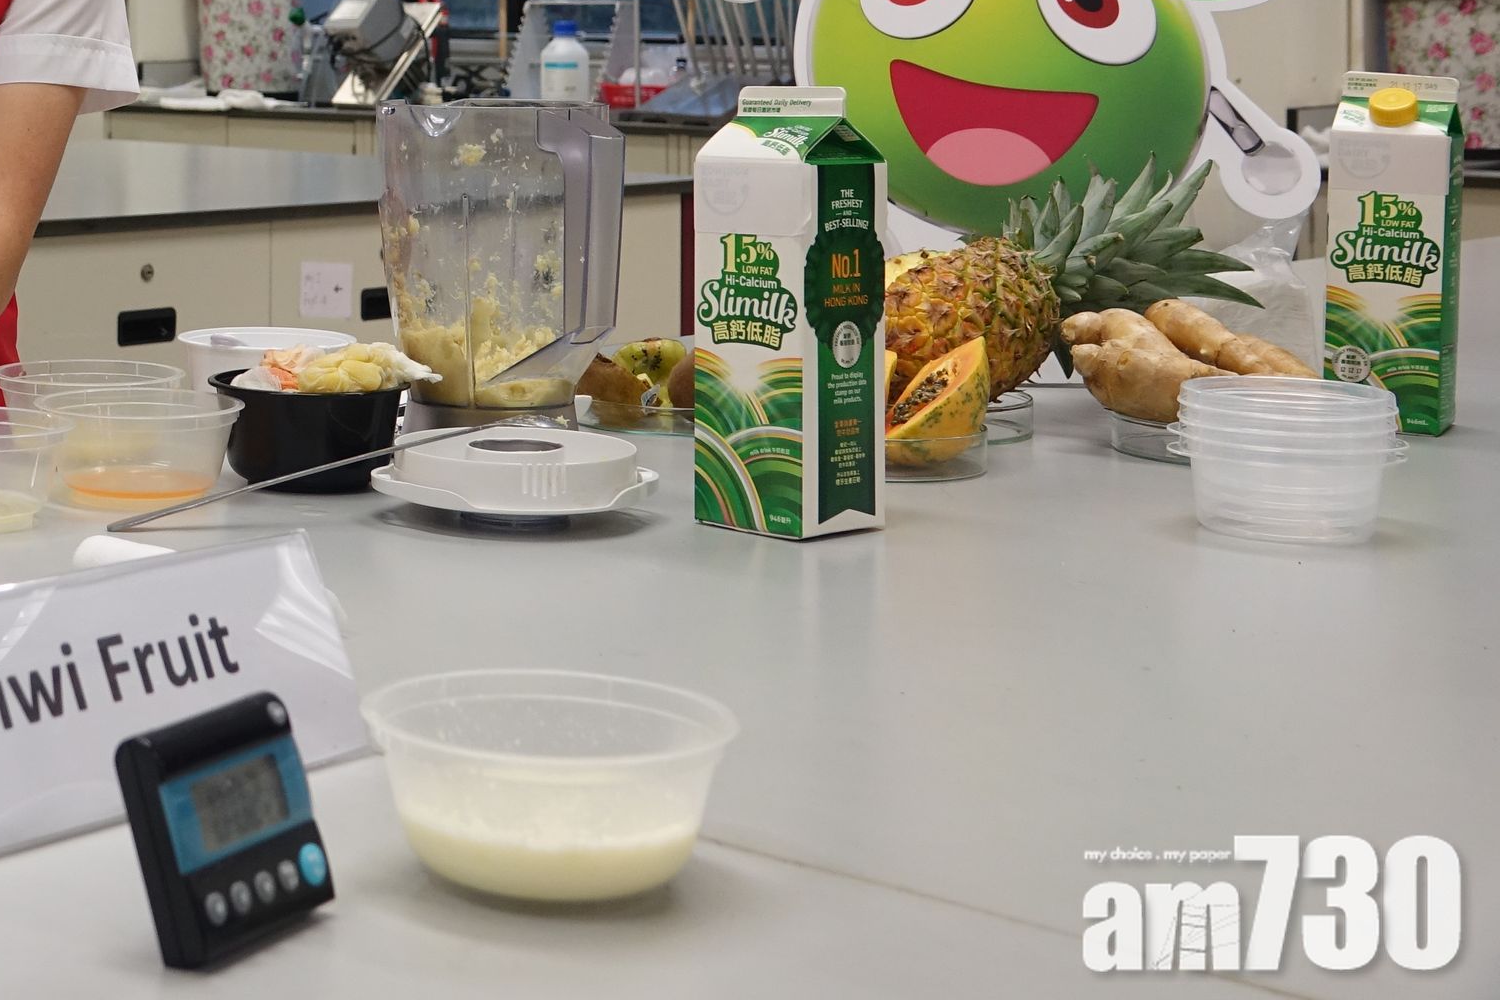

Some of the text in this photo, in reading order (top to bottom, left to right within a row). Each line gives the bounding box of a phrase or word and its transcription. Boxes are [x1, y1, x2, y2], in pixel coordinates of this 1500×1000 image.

[790, 99, 812, 107] Delivery
[840, 189, 854, 198] THE
[831, 199, 863, 210] FRESHEST
[1358, 192, 1416, 226] 1.5%
[824, 218, 869, 232] BEST-SELLING!
[1381, 219, 1416, 228] LOW FAT
[1362, 227, 1420, 239] Hi-Calcium
[721, 234, 774, 273] 1.5%
[1332, 231, 1438, 271] Slimilk
[742, 265, 774, 276] LOW FAT
[1347, 263, 1423, 286] 高鈣低脂
[725, 274, 778, 289] Hi-Calcium
[832, 284, 851, 294] MILK
[698, 280, 796, 329] Slimilk
[824, 294, 868, 308] HONG KONG
[712, 319, 781, 348] 高鈣低脂
[97, 613, 240, 703] Fruit
